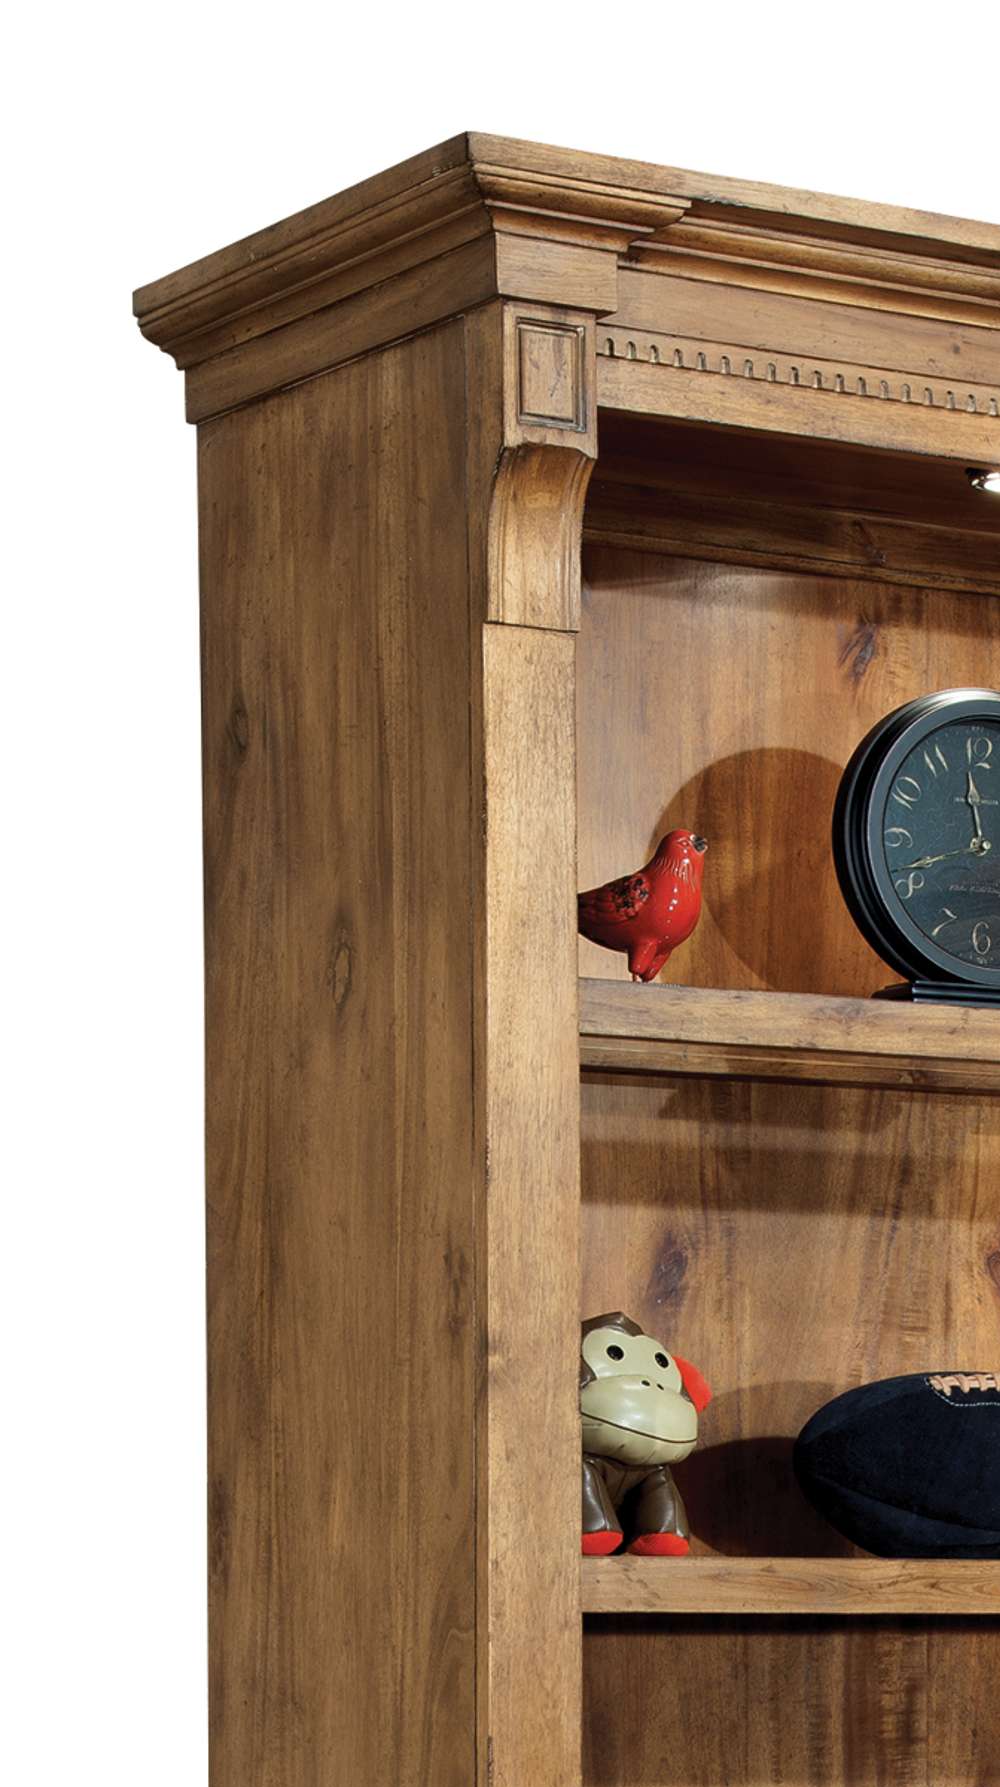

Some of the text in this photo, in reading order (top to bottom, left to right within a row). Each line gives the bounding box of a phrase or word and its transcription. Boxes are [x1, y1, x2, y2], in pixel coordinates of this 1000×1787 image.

[924, 745, 948, 777] 11
[966, 737, 993, 769] 12
[891, 776, 921, 810] 10
[884, 827, 914, 848] 9
[895, 871, 925, 900] 8
[932, 908, 957, 936] 7
[972, 921, 991, 955] 6
